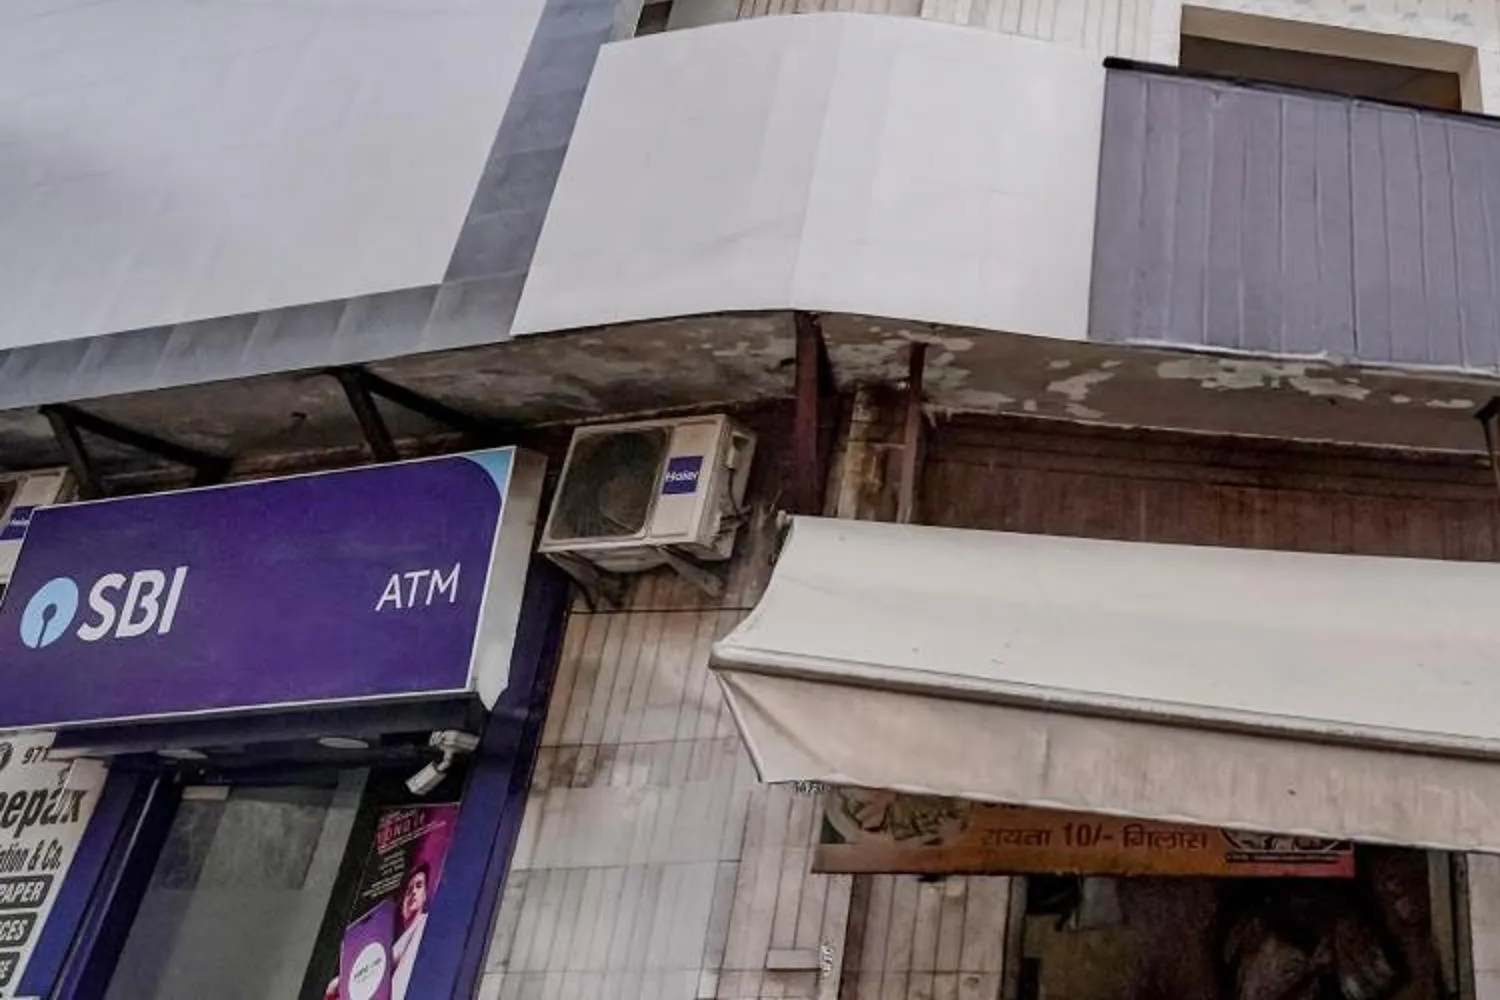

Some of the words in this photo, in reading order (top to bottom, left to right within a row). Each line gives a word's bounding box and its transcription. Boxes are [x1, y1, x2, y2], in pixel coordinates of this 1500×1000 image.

[76, 566, 188, 641] SBI
[375, 562, 461, 611] ATM
[1063, 822, 1114, 847] 10/-
